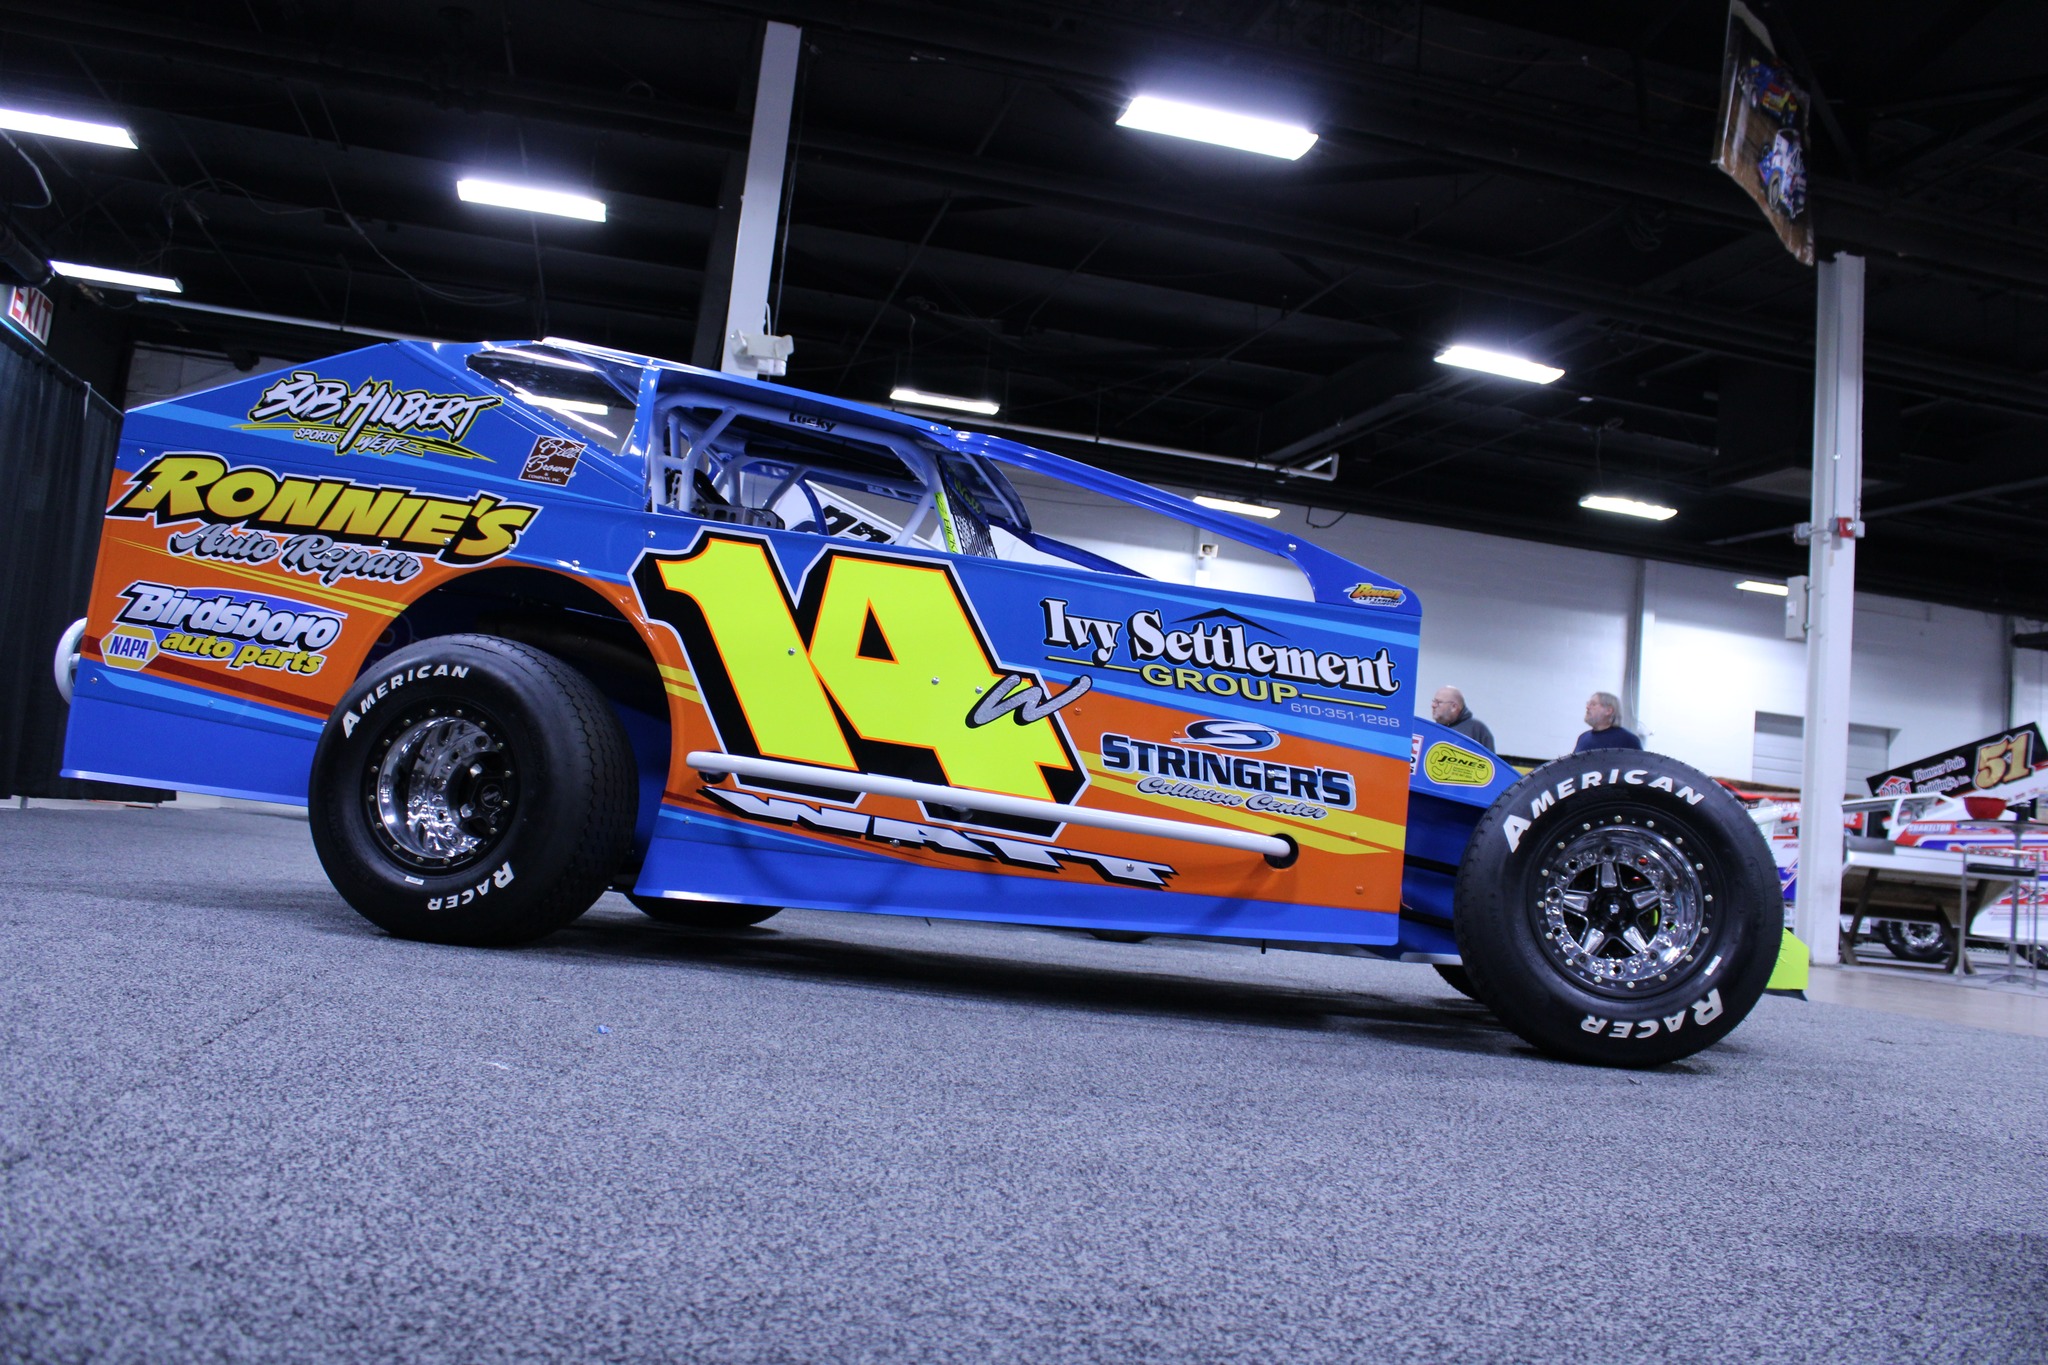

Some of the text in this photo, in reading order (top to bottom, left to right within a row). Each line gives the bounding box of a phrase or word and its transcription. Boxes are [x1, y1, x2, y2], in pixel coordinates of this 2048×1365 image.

[11, 288, 53, 340] EXIT
[252, 373, 502, 454] BOB HILBERT
[788, 411, 837, 432] Lucky
[295, 427, 422, 455] SPORTS WEAR
[118, 457, 538, 558] RONNIE'S
[173, 523, 422, 583] Auto Repair
[118, 583, 340, 650] Birdsboro
[109, 635, 149, 659] NAPA
[160, 632, 325, 674] auto parts
[1041, 598, 1400, 693] Ivy Settlement
[341, 664, 469, 738] AMERICAN
[1141, 664, 1299, 704] GROUP
[1101, 733, 1355, 810] STRINGER'S
[1437, 755, 1487, 769] JONES
[1974, 732, 2032, 789] 51
[1137, 776, 1328, 819] Collision Center
[1503, 769, 1705, 853] AMERICAN
[426, 861, 516, 911] RACER
[1580, 988, 1724, 1039] RACER
